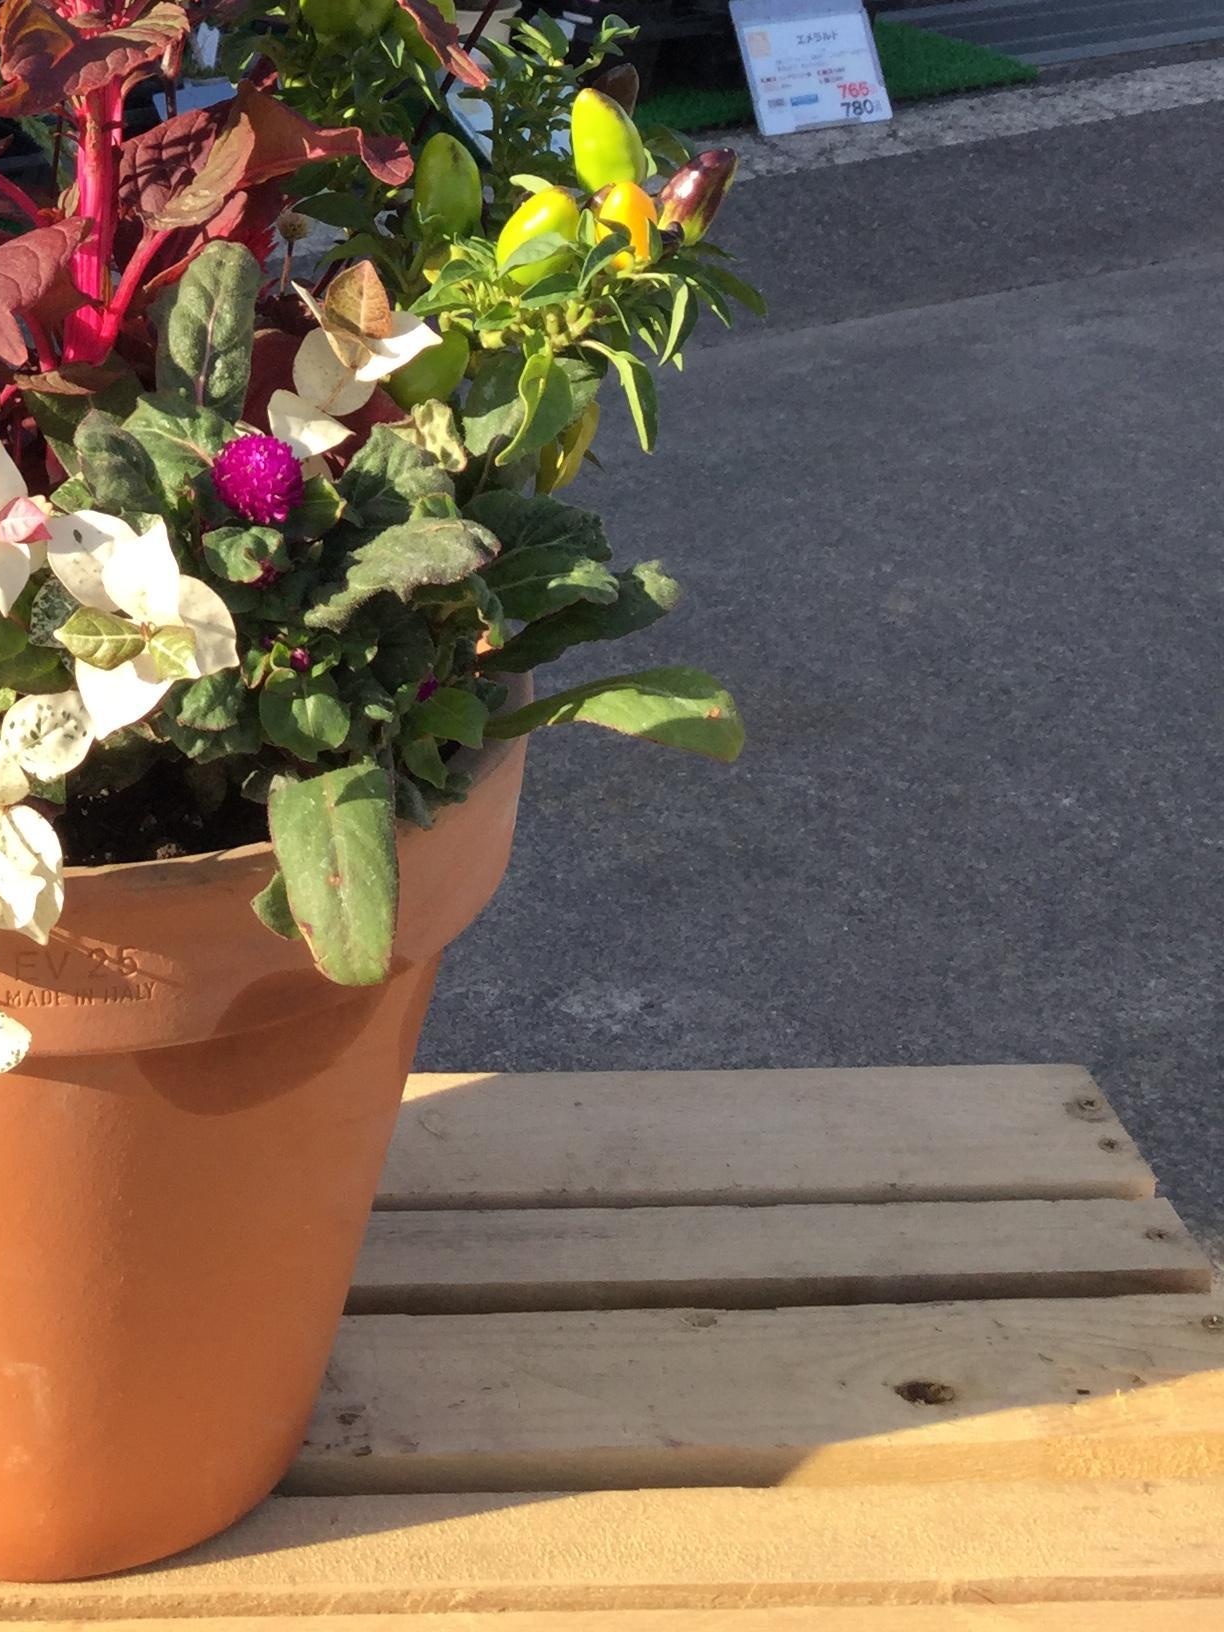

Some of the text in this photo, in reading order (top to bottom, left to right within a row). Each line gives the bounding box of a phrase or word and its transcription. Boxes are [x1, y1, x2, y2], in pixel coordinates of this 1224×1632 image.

[837, 80, 870, 99] 765
[840, 99, 874, 117] 780
[5, 981, 157, 1009] MADE IN ITALY
